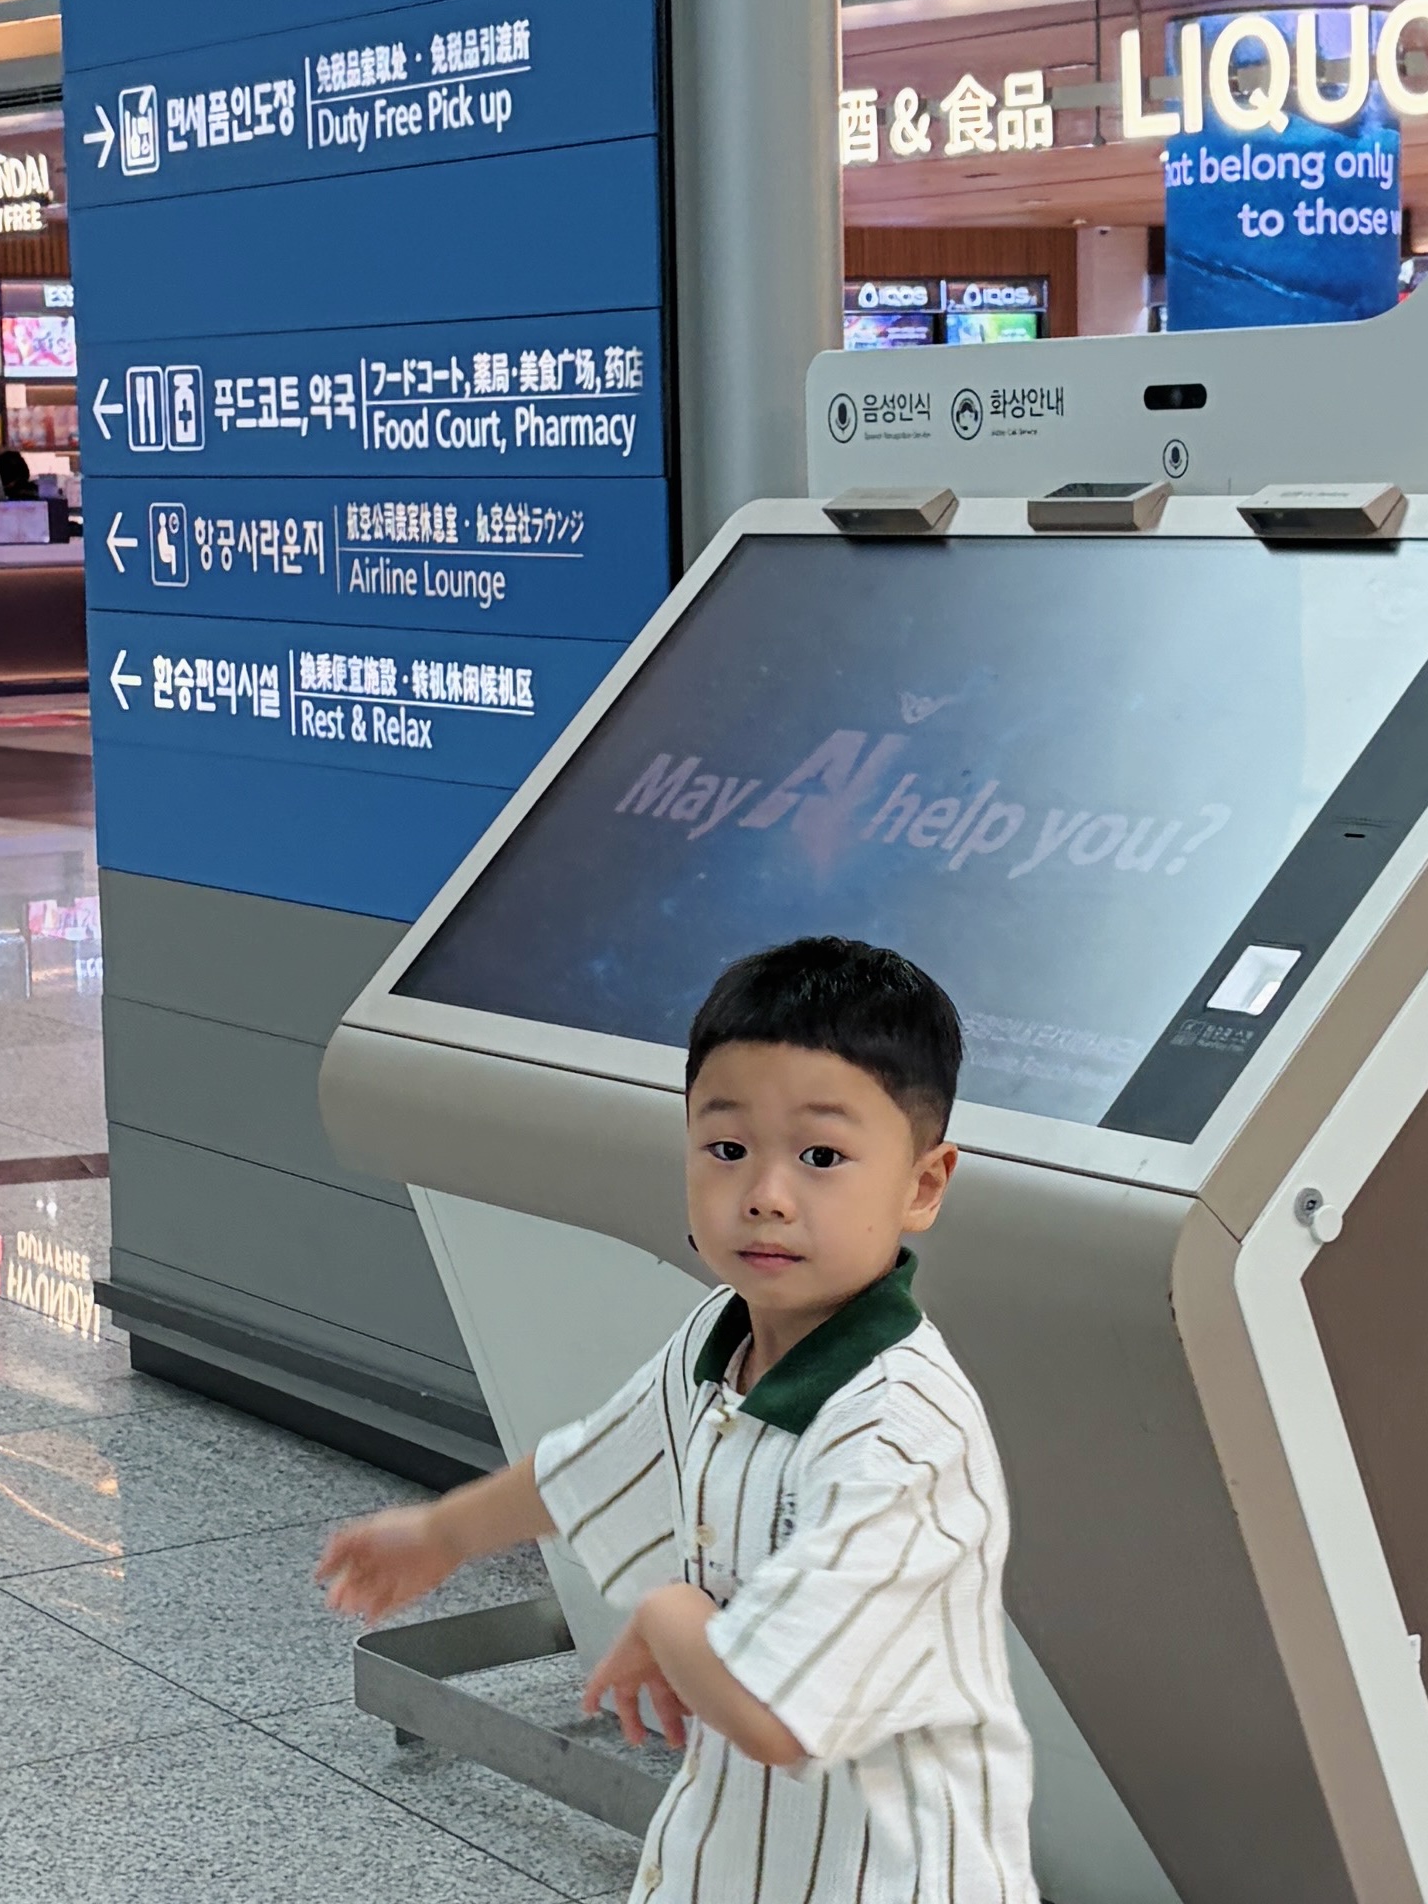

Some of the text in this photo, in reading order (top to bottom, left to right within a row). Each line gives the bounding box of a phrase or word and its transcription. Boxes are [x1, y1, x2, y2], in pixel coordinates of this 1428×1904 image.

[167, 78, 296, 153] 면세품인도장
[317, 83, 513, 153] Duty Free Pick up
[938, 68, 1055, 156] 食品
[1199, 143, 1326, 190] belong
[1335, 142, 1395, 191] only
[1237, 203, 1285, 238] to
[1293, 196, 1389, 236] those
[878, 285, 929, 307] IQOS
[983, 286, 1029, 306] IQOS
[862, 393, 931, 423] 음성인식
[989, 386, 1064, 419] 화상안내
[373, 403, 637, 457] Food Court, Pharmacy
[194, 515, 325, 575] 항공사라운지
[349, 556, 507, 609] Airline Lounge
[152, 654, 281, 719] 환승편의시설
[302, 699, 433, 750] Rest & Relax
[614, 753, 764, 841] May
[858, 772, 1027, 872] help
[1008, 802, 1233, 880] you?
